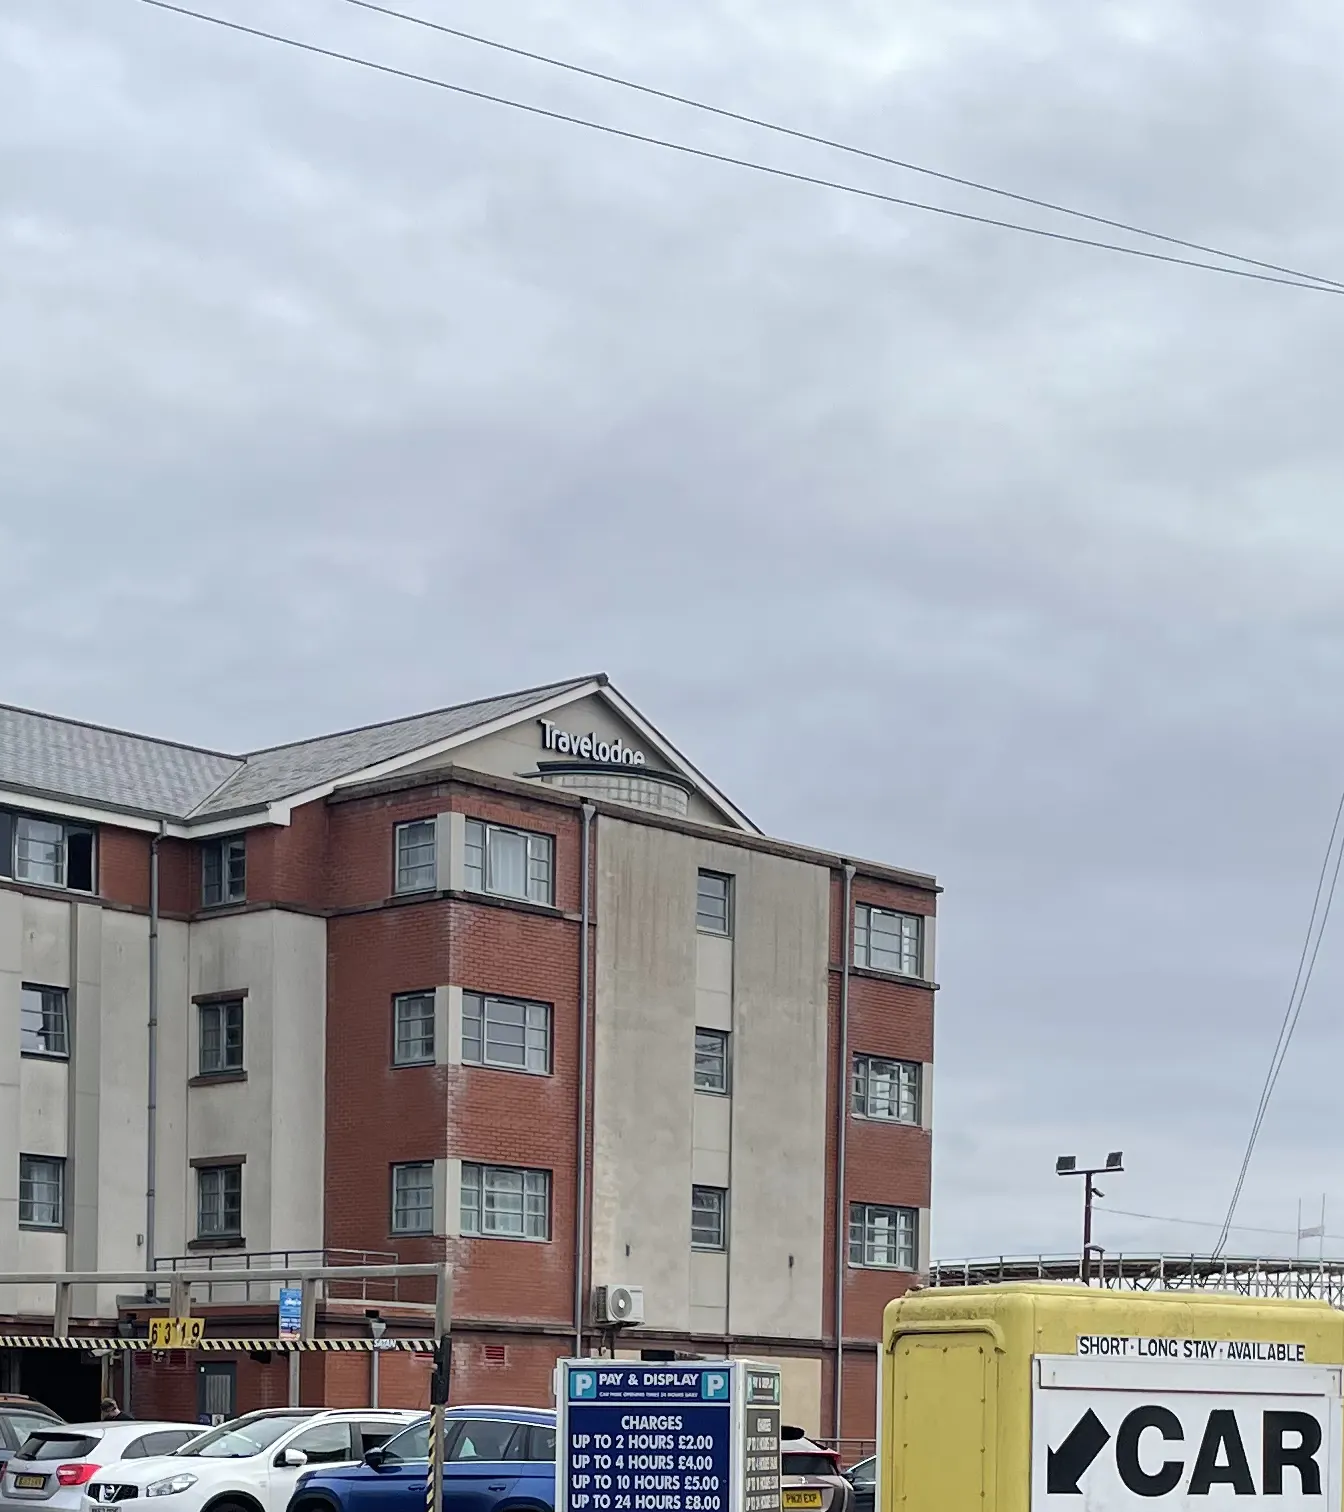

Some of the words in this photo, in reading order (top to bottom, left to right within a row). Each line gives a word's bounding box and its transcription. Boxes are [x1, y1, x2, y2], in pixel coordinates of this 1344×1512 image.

[1079, 1336, 1129, 1355] SHORT
[1138, 1339, 1178, 1357] LONG
[1183, 1340, 1218, 1358] STAY
[1227, 1341, 1306, 1362] AVAILABLE
[599, 1373, 624, 1386] PAY
[628, 1374, 639, 1386] &
[644, 1373, 699, 1386] DISPLAY
[621, 1415, 683, 1430] CHARGES
[572, 1434, 590, 1449] UP
[594, 1434, 611, 1449] TO
[616, 1435, 624, 1449] 2
[628, 1435, 674, 1449] HOURS
[678, 1435, 713, 1450] £2.00
[1115, 1405, 1322, 1497] CAR
[572, 1454, 590, 1469] UP
[594, 1454, 611, 1469] TO
[615, 1455, 624, 1469] 4
[628, 1455, 674, 1469] HOURS
[678, 1455, 713, 1470] £4.00
[572, 1474, 590, 1489] UP
[594, 1474, 611, 1489] TO
[617, 1475, 630, 1489] 10
[634, 1475, 680, 1490] HOURS
[684, 1476, 719, 1490] £5.00
[571, 1494, 589, 1508] UP
[593, 1494, 610, 1509] TO
[615, 1495, 631, 1509] 24
[635, 1495, 681, 1509] HOURS
[685, 1495, 720, 1510] £8.00
